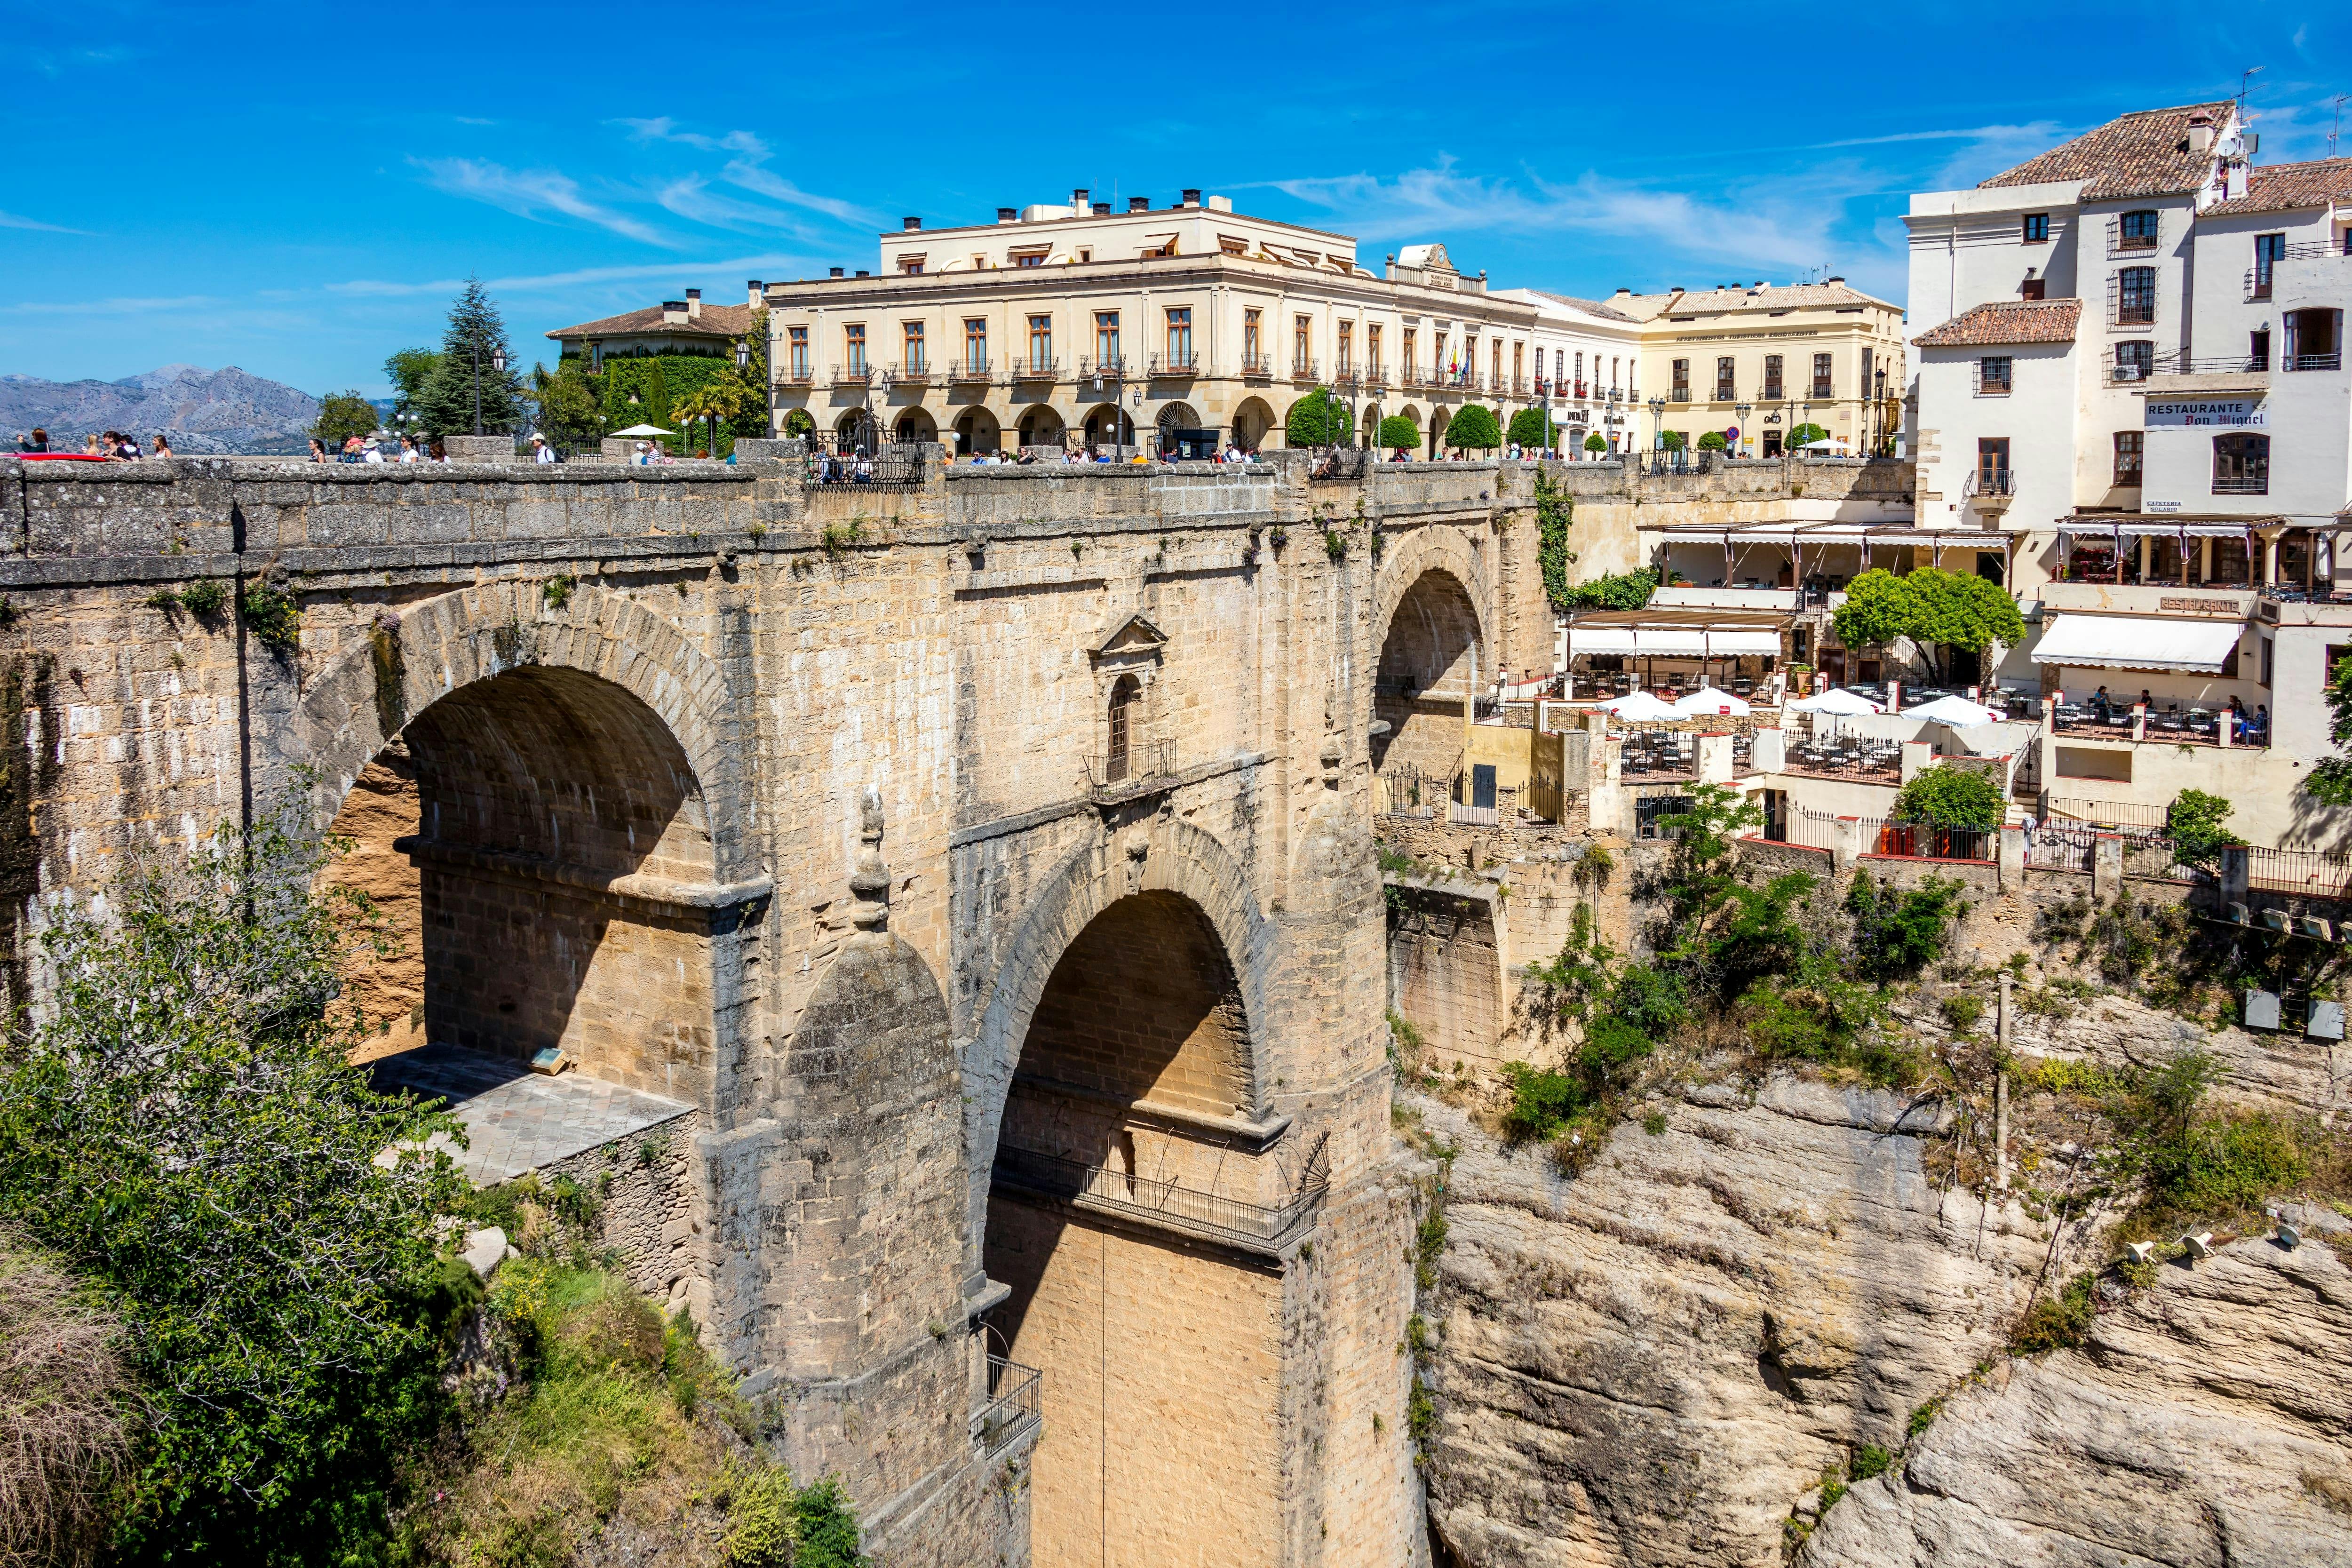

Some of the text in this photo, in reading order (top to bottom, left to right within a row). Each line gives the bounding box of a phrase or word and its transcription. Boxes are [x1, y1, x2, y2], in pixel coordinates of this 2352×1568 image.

[2148, 404, 2242, 414] RESTAURANTE
[1604, 416, 1624, 424] Monald's
[2185, 414, 2264, 427] Don Miguel
[2162, 598, 2239, 612] RESTAURANTE
